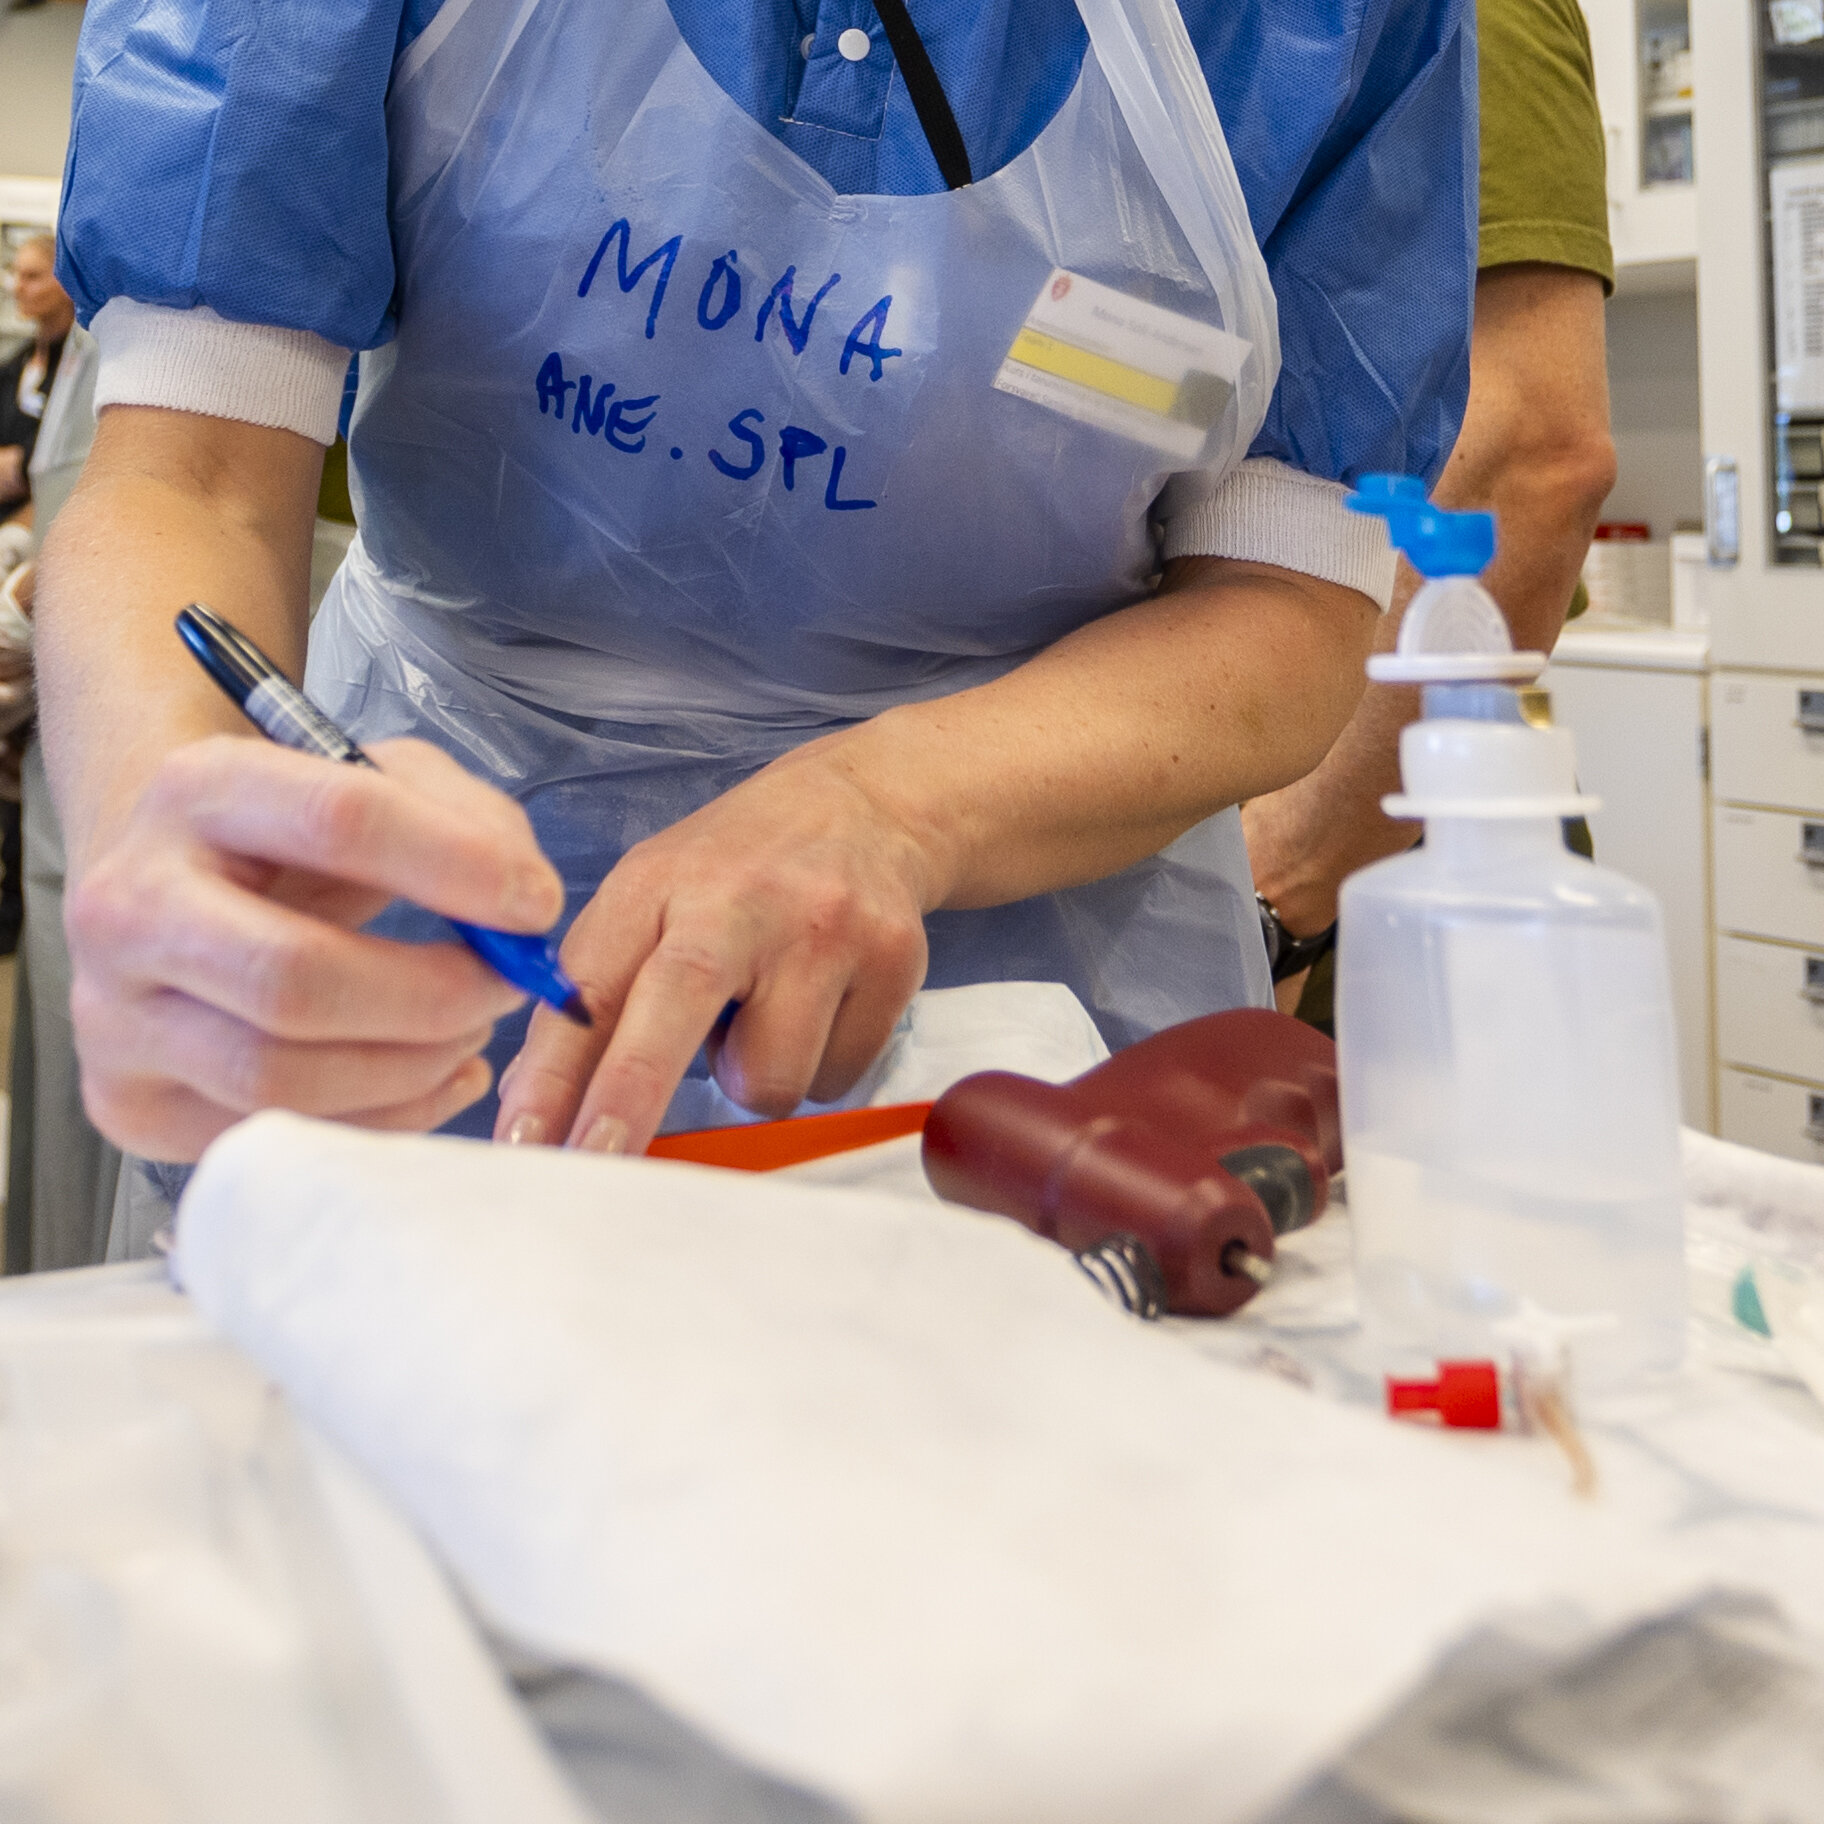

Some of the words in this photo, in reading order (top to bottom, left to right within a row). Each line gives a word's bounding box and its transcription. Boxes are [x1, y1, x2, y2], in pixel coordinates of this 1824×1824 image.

[577, 217, 903, 383] MONA
[535, 351, 684, 461] ANE.
[707, 407, 878, 512] SPL
